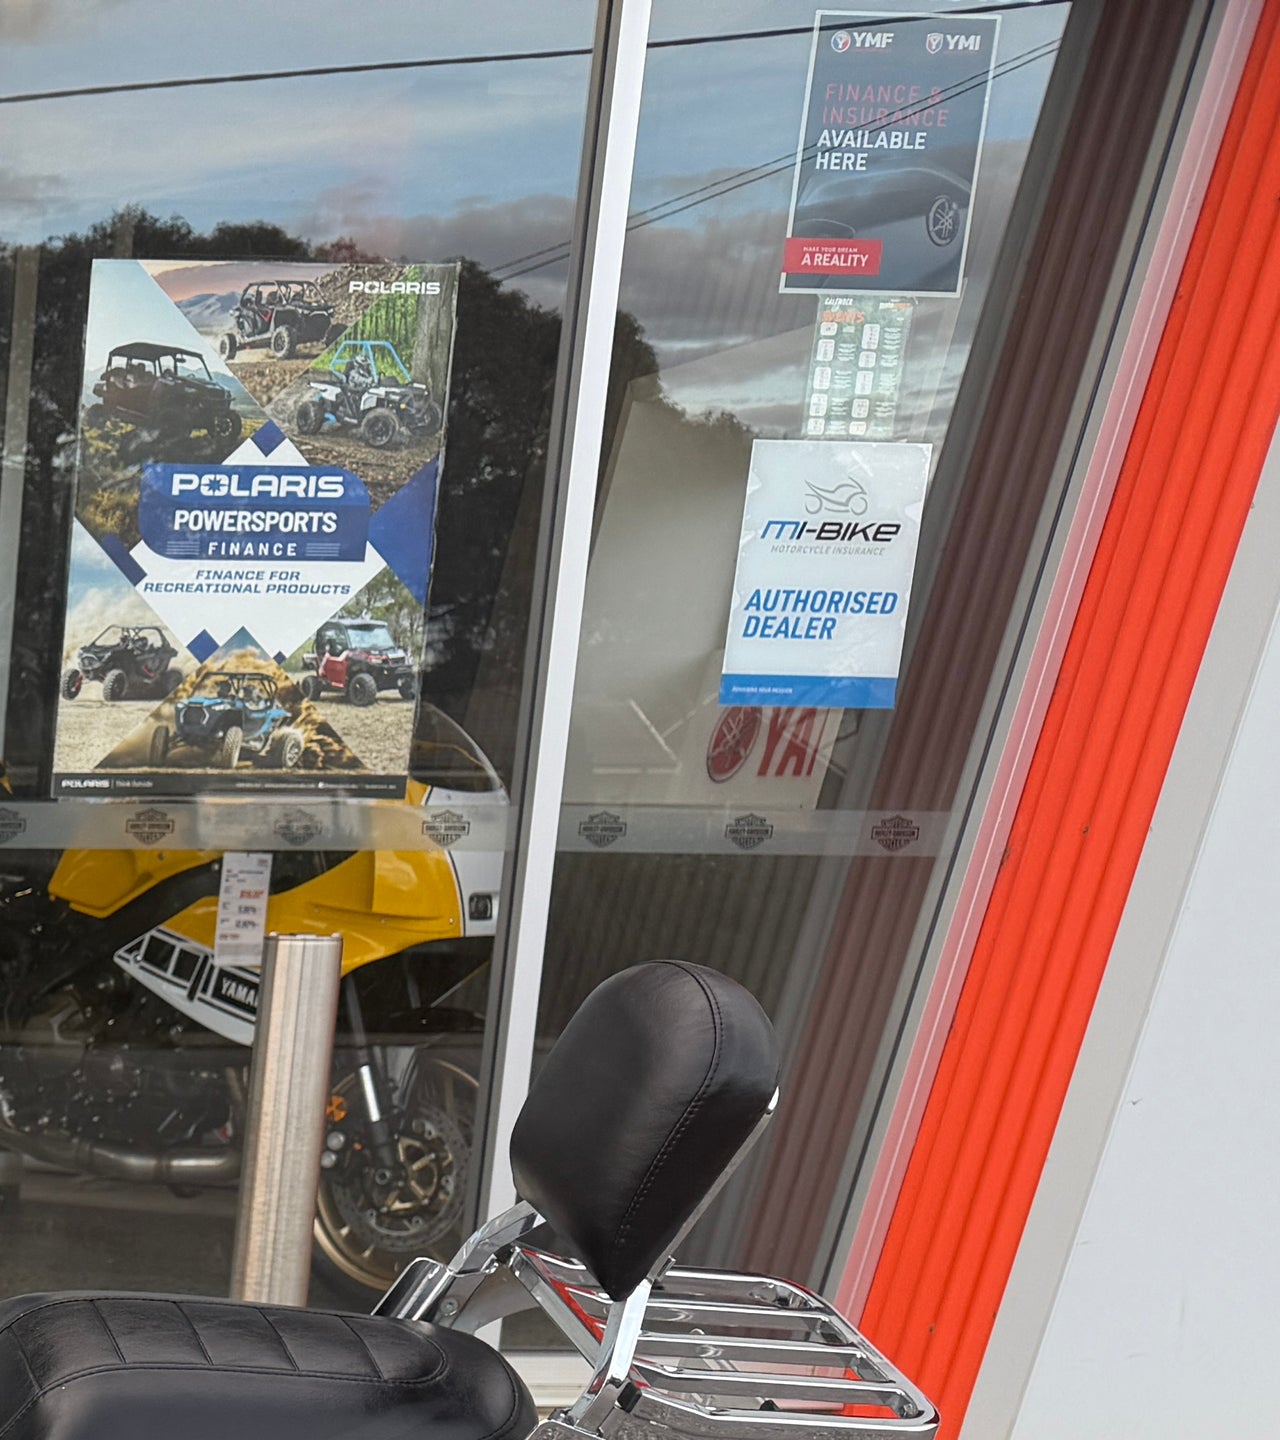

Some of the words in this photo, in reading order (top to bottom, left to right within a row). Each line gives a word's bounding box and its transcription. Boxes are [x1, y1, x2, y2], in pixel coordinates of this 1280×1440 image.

[853, 32, 894, 48] YMF
[946, 35, 981, 50] YMI
[825, 83, 921, 103] FINANCE
[822, 107, 949, 127] INSURANCE
[816, 129, 927, 150] AVAILABLE
[815, 152, 868, 170] HERE
[801, 254, 811, 266] A
[814, 254, 868, 267] REALITY
[349, 281, 440, 295] POLARIS
[171, 473, 345, 498] POLARIS
[173, 510, 338, 533] POWERSPORTS
[208, 542, 297, 556] FINANCE
[771, 544, 831, 555] MOTORCYCLE
[832, 545, 886, 556] INSURANCE
[195, 570, 264, 580] FINANCE
[269, 571, 301, 581] FOR
[144, 582, 261, 593] RECREATIONAL
[266, 584, 351, 595] PRODUCTS
[744, 589, 898, 615] AUTHORISED
[742, 615, 837, 640] DEALER
[222, 977, 259, 1006] YAMA
